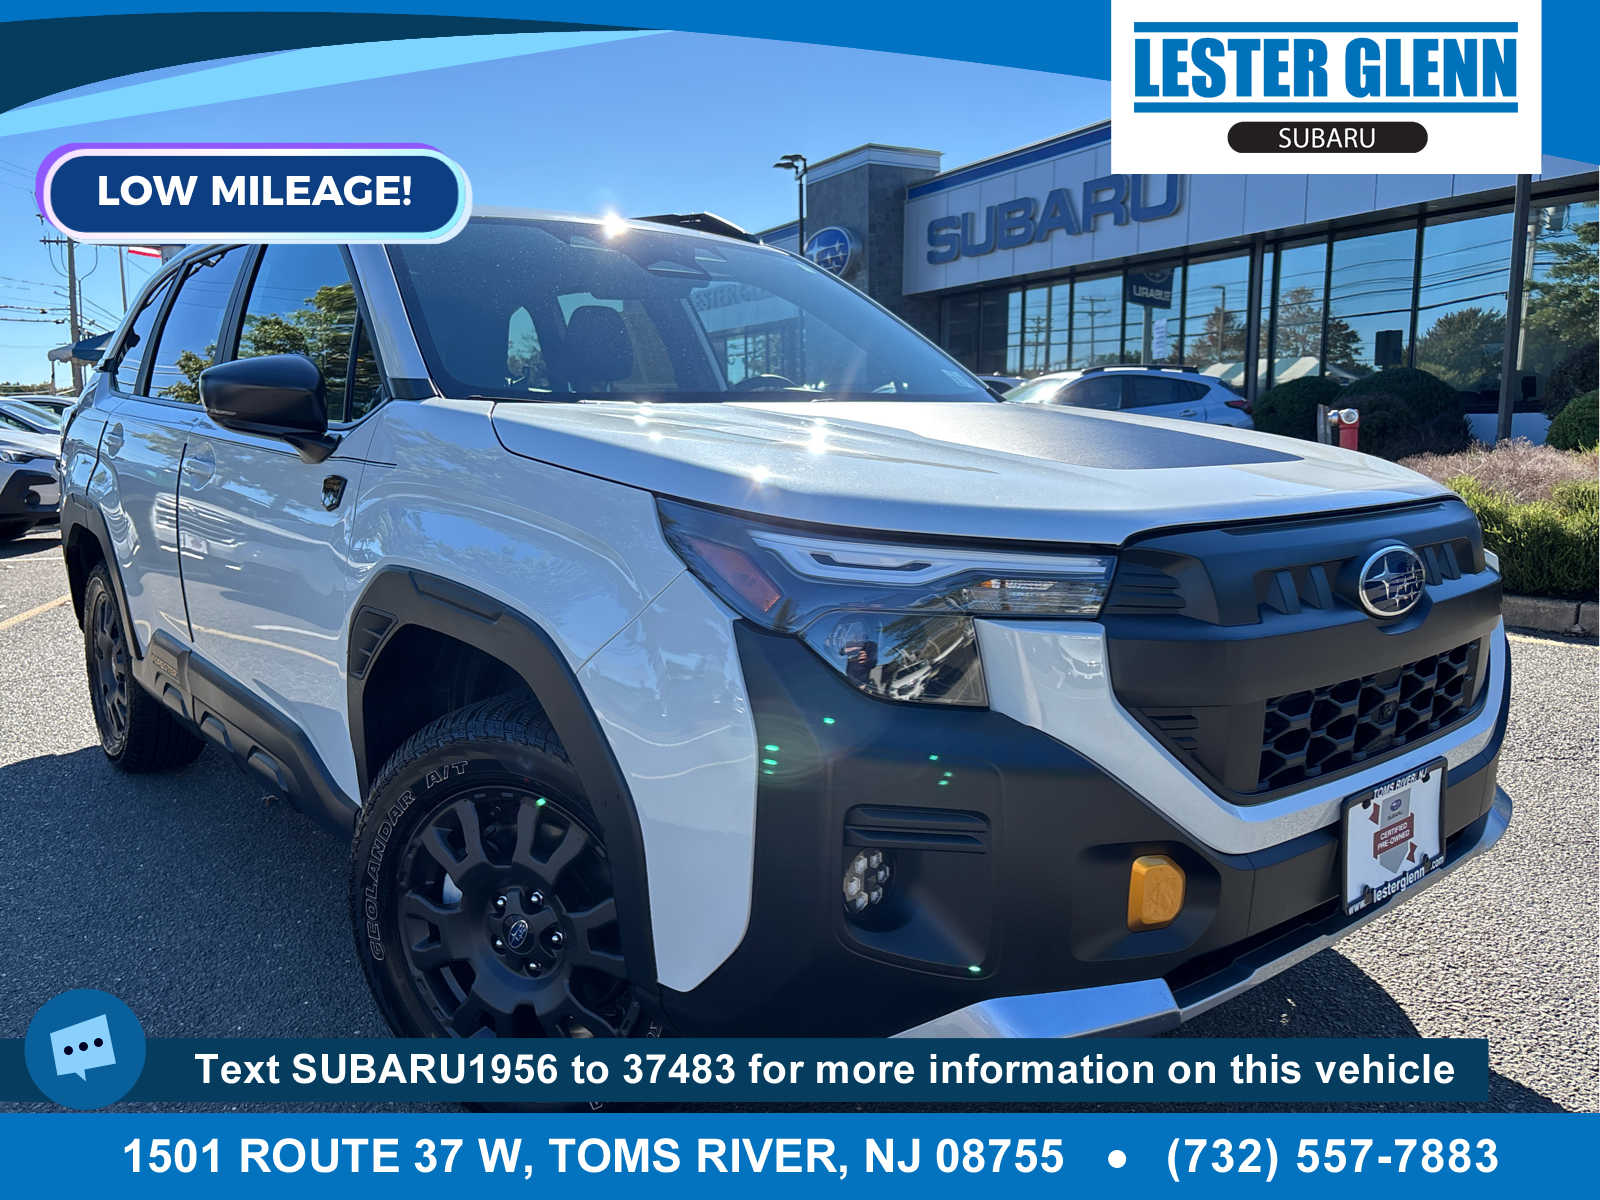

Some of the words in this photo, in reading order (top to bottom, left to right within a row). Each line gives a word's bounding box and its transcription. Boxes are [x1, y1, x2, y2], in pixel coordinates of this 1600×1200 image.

[926, 174, 1182, 265] SUBARU
[1373, 782, 1396, 799] TOMS
[1377, 829, 1410, 850] PRE-OWNED
[1379, 822, 1408, 841] CERTIFIED
[365, 790, 417, 961] GEOLANDAR
[426, 760, 469, 789] A/T
